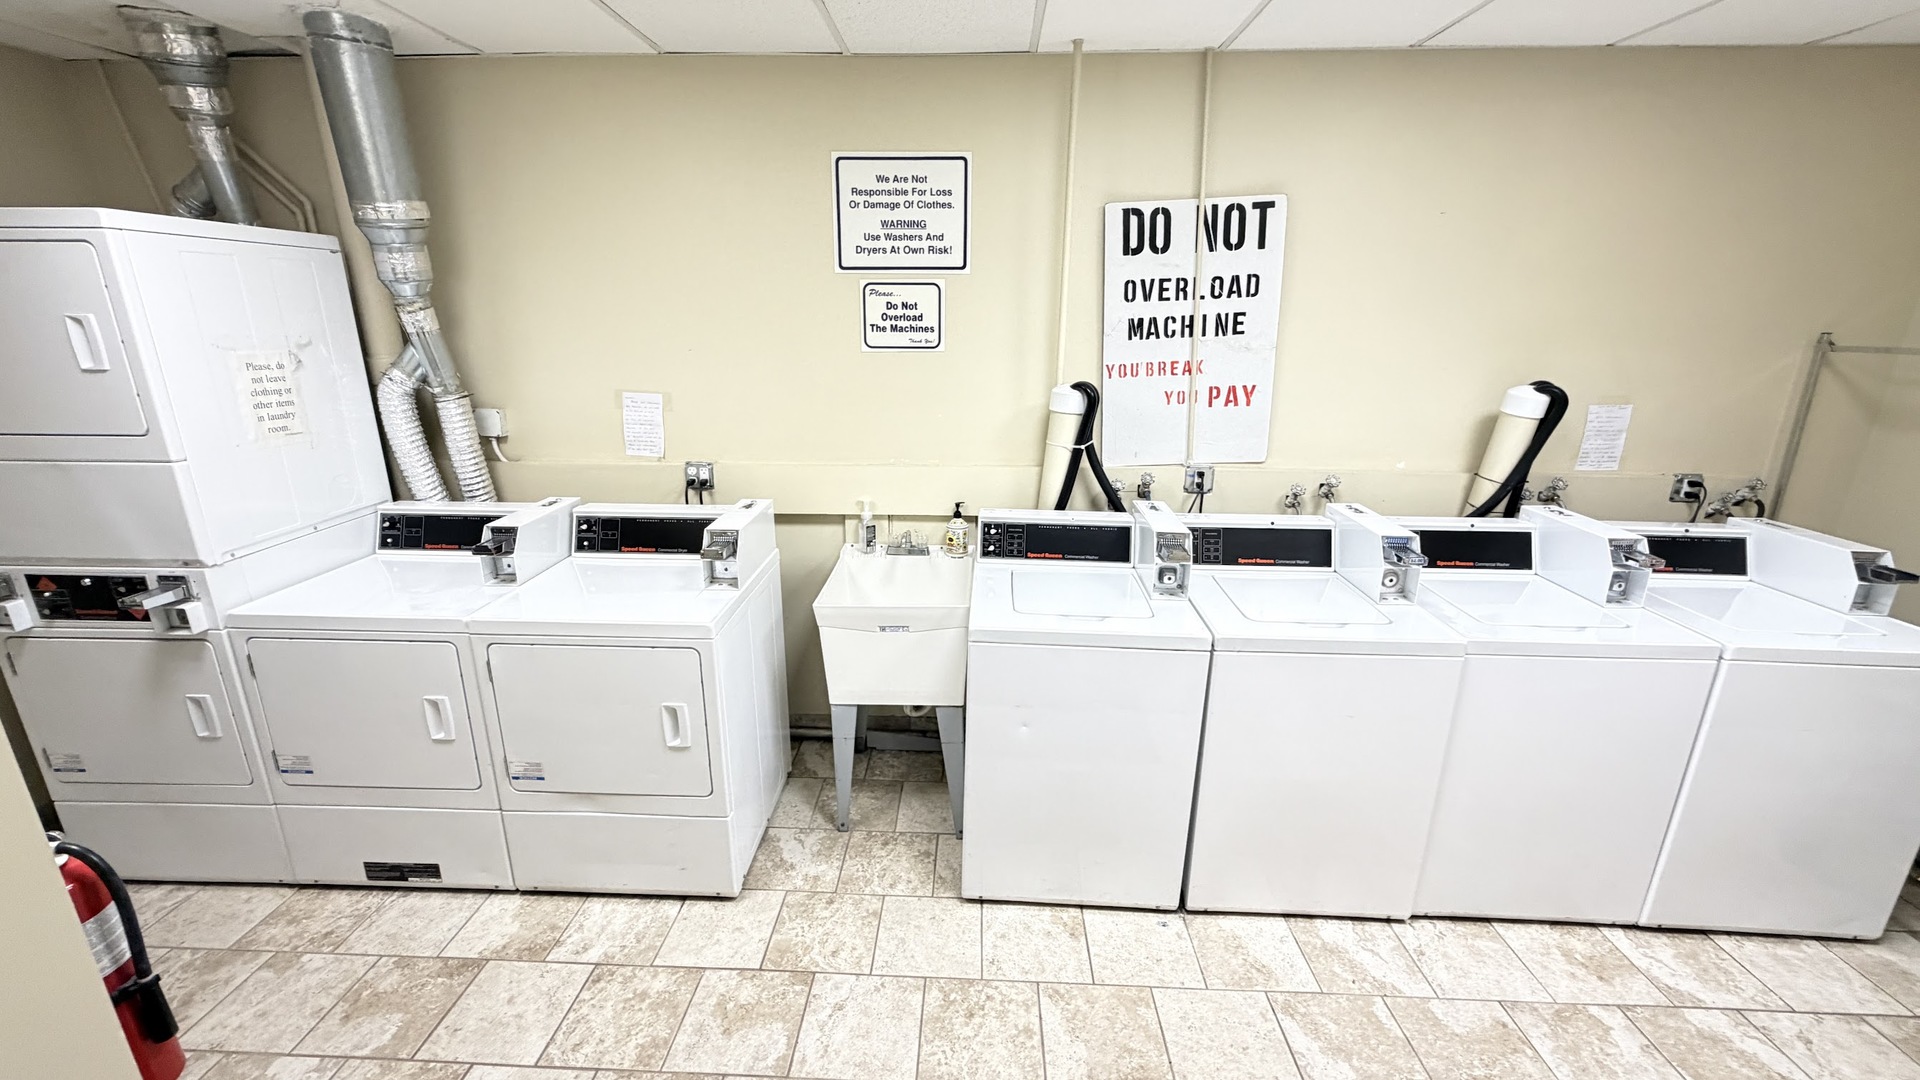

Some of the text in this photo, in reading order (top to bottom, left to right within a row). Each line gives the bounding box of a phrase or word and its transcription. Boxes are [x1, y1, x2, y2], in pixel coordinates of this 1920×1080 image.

[875, 174, 928, 184] We Are Not
[851, 187, 953, 198] Responsible For Loss
[849, 200, 955, 211] Or Damage Of Clothes.
[880, 219, 927, 230] WARNING
[1121, 200, 1276, 256] DO NOT
[863, 233, 944, 242] Use Washers And
[855, 245, 953, 257] Dryers At Own Risk!
[885, 301, 918, 310] Do Not
[881, 312, 923, 321] Overload
[869, 323, 935, 333] The Machines
[1128, 311, 1247, 341] MACHINE
[245, 361, 286, 371] Please, do
[251, 374, 286, 384] not leave
[250, 387, 283, 397] clothing
[1208, 384, 1257, 408] PAY
[252, 399, 295, 410] other items
[257, 411, 296, 422] in laundry
[267, 426, 291, 434] room.
